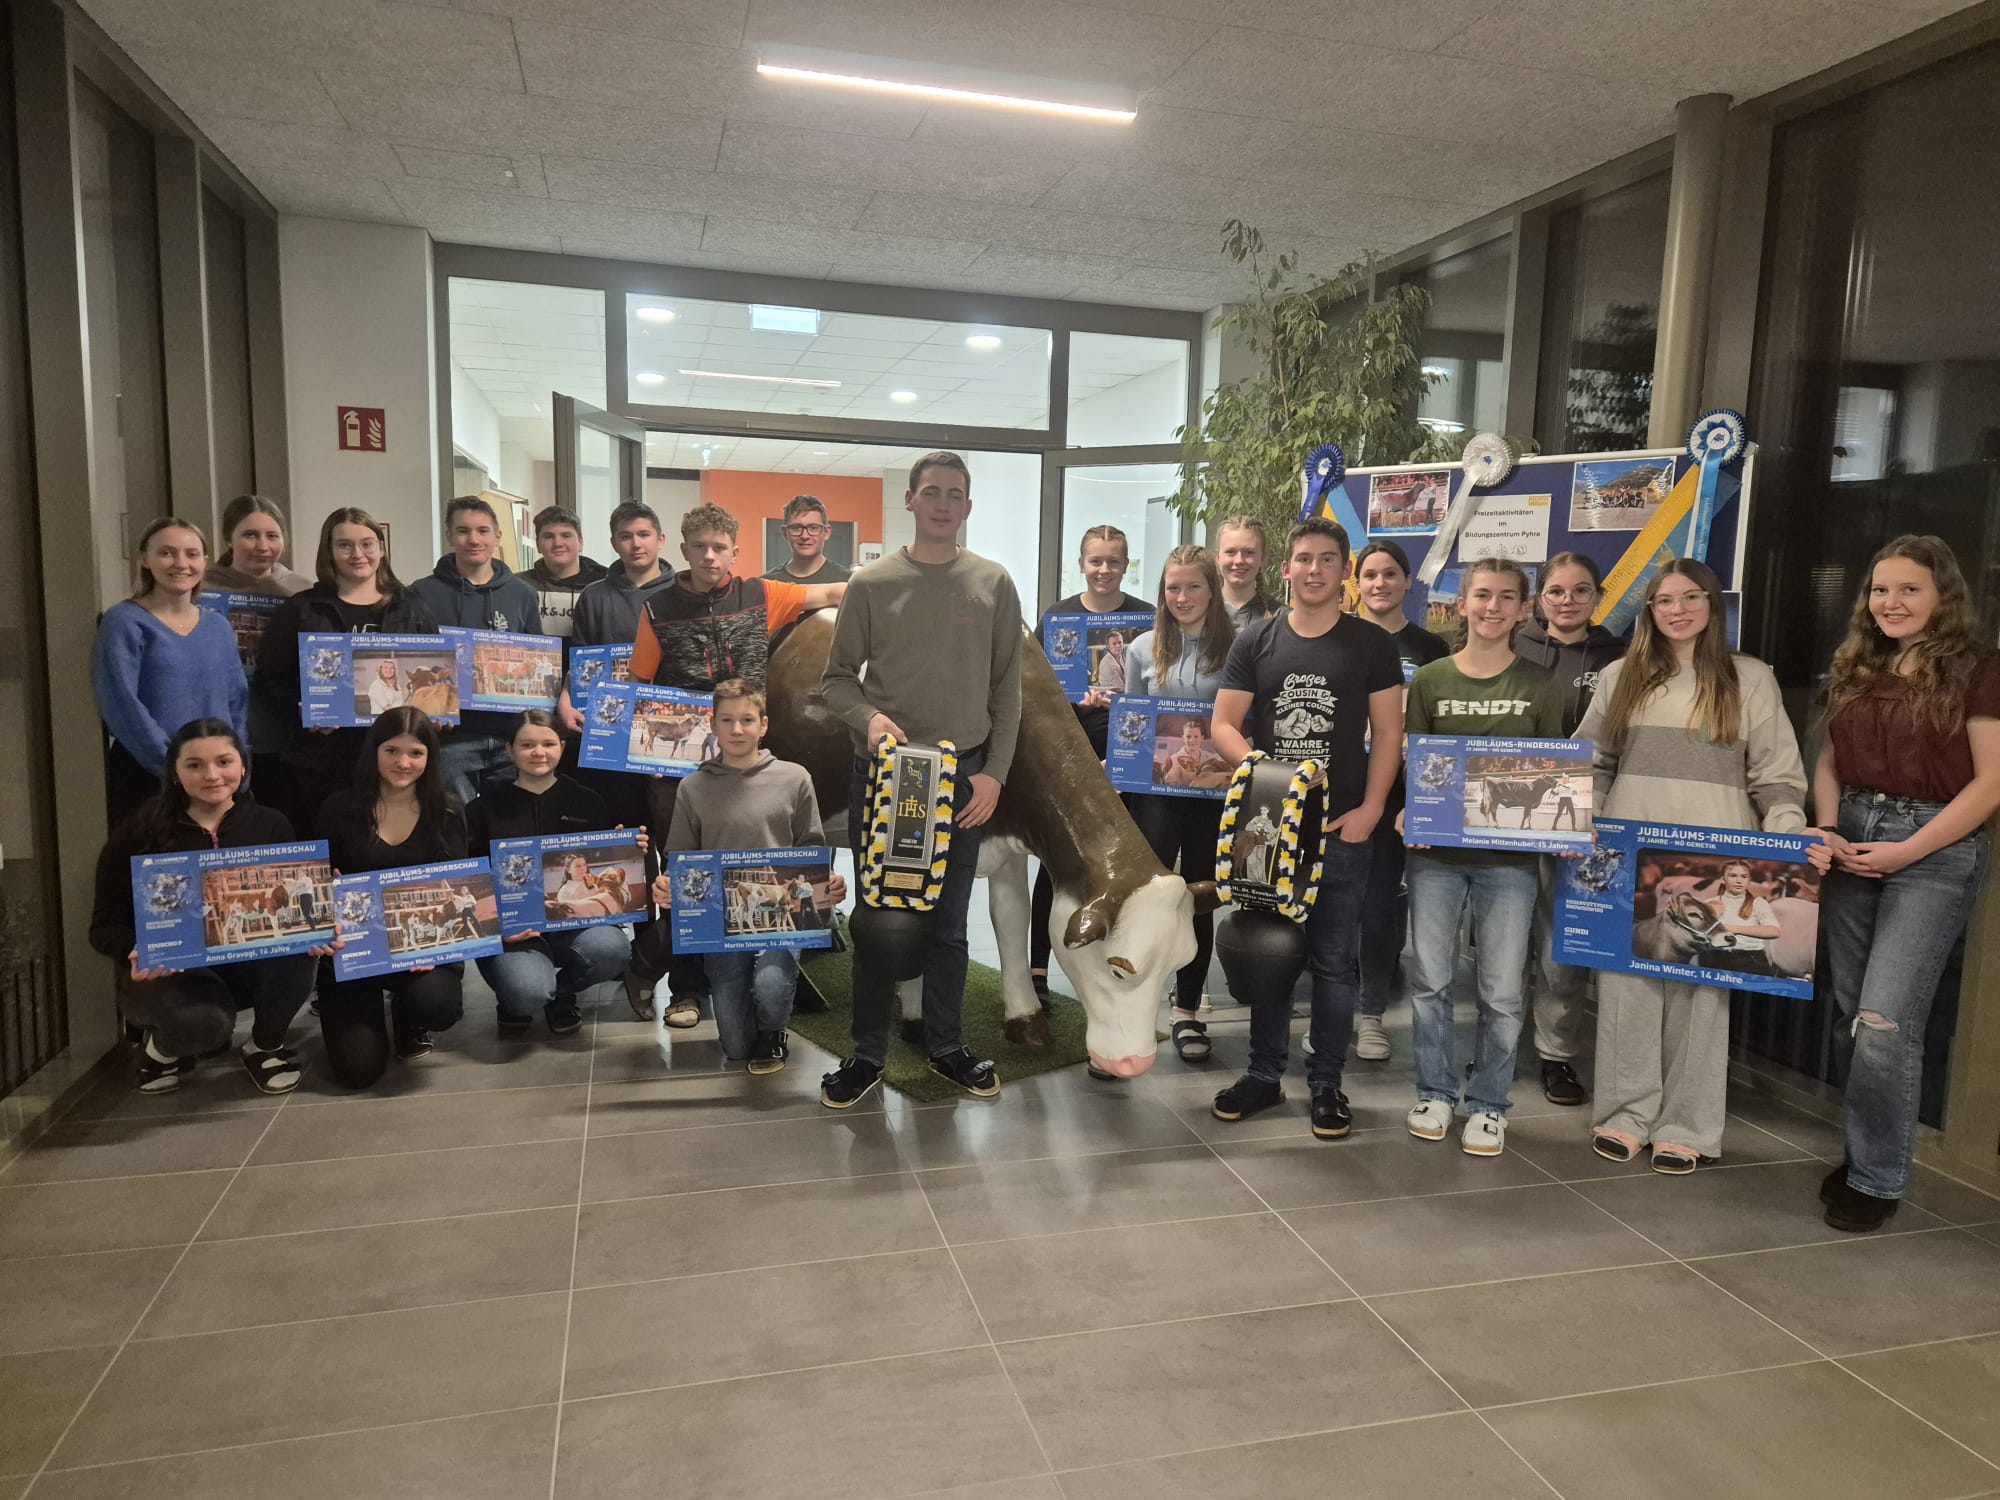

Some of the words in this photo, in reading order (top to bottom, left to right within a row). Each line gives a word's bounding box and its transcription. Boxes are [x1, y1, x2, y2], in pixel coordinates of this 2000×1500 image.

[1473, 509, 1534, 517] Freizeitaktivitäten
[1465, 531, 1521, 539] Bildungszentrum
[1521, 530, 1541, 538] Pyhra
[1086, 614, 1156, 622] JUBILÄUMS-RINDERSC
[1283, 673, 1328, 690] Großer
[1281, 689, 1319, 700] COUSIN
[1321, 690, 1328, 698] &
[1275, 701, 1305, 716] KLEINER
[1305, 701, 1335, 716] COUSIN
[1437, 699, 1532, 717] FENDT
[1281, 739, 1323, 749] WAHRE
[1466, 738, 1580, 751] JUBILÄUMS-RINDERSCHAU
[896, 801, 927, 819] IHS
[1462, 837, 1490, 845] Melanie
[1491, 838, 1537, 849] Mittenhuber,
[1547, 841, 1569, 850] Jahre
[1637, 826, 1802, 850] JUBILÄUMS-RINDERSCHAU
[1646, 837, 1668, 845] JAHRE
[1674, 839, 1685, 847] NÖ
[1685, 841, 1717, 850] GENETIK
[198, 844, 317, 862] JUBILÄUMS-RINDERSCHAU
[720, 849, 819, 861] JUBILÄUMS-RINDERSCHAU
[378, 860, 479, 881] JUBILÄUMS-RINDERSCHAU
[1629, 960, 1661, 972] Janina
[1662, 964, 1698, 978] Winter,
[1701, 970, 1712, 980] 14
[1714, 972, 1744, 984] Jahre
